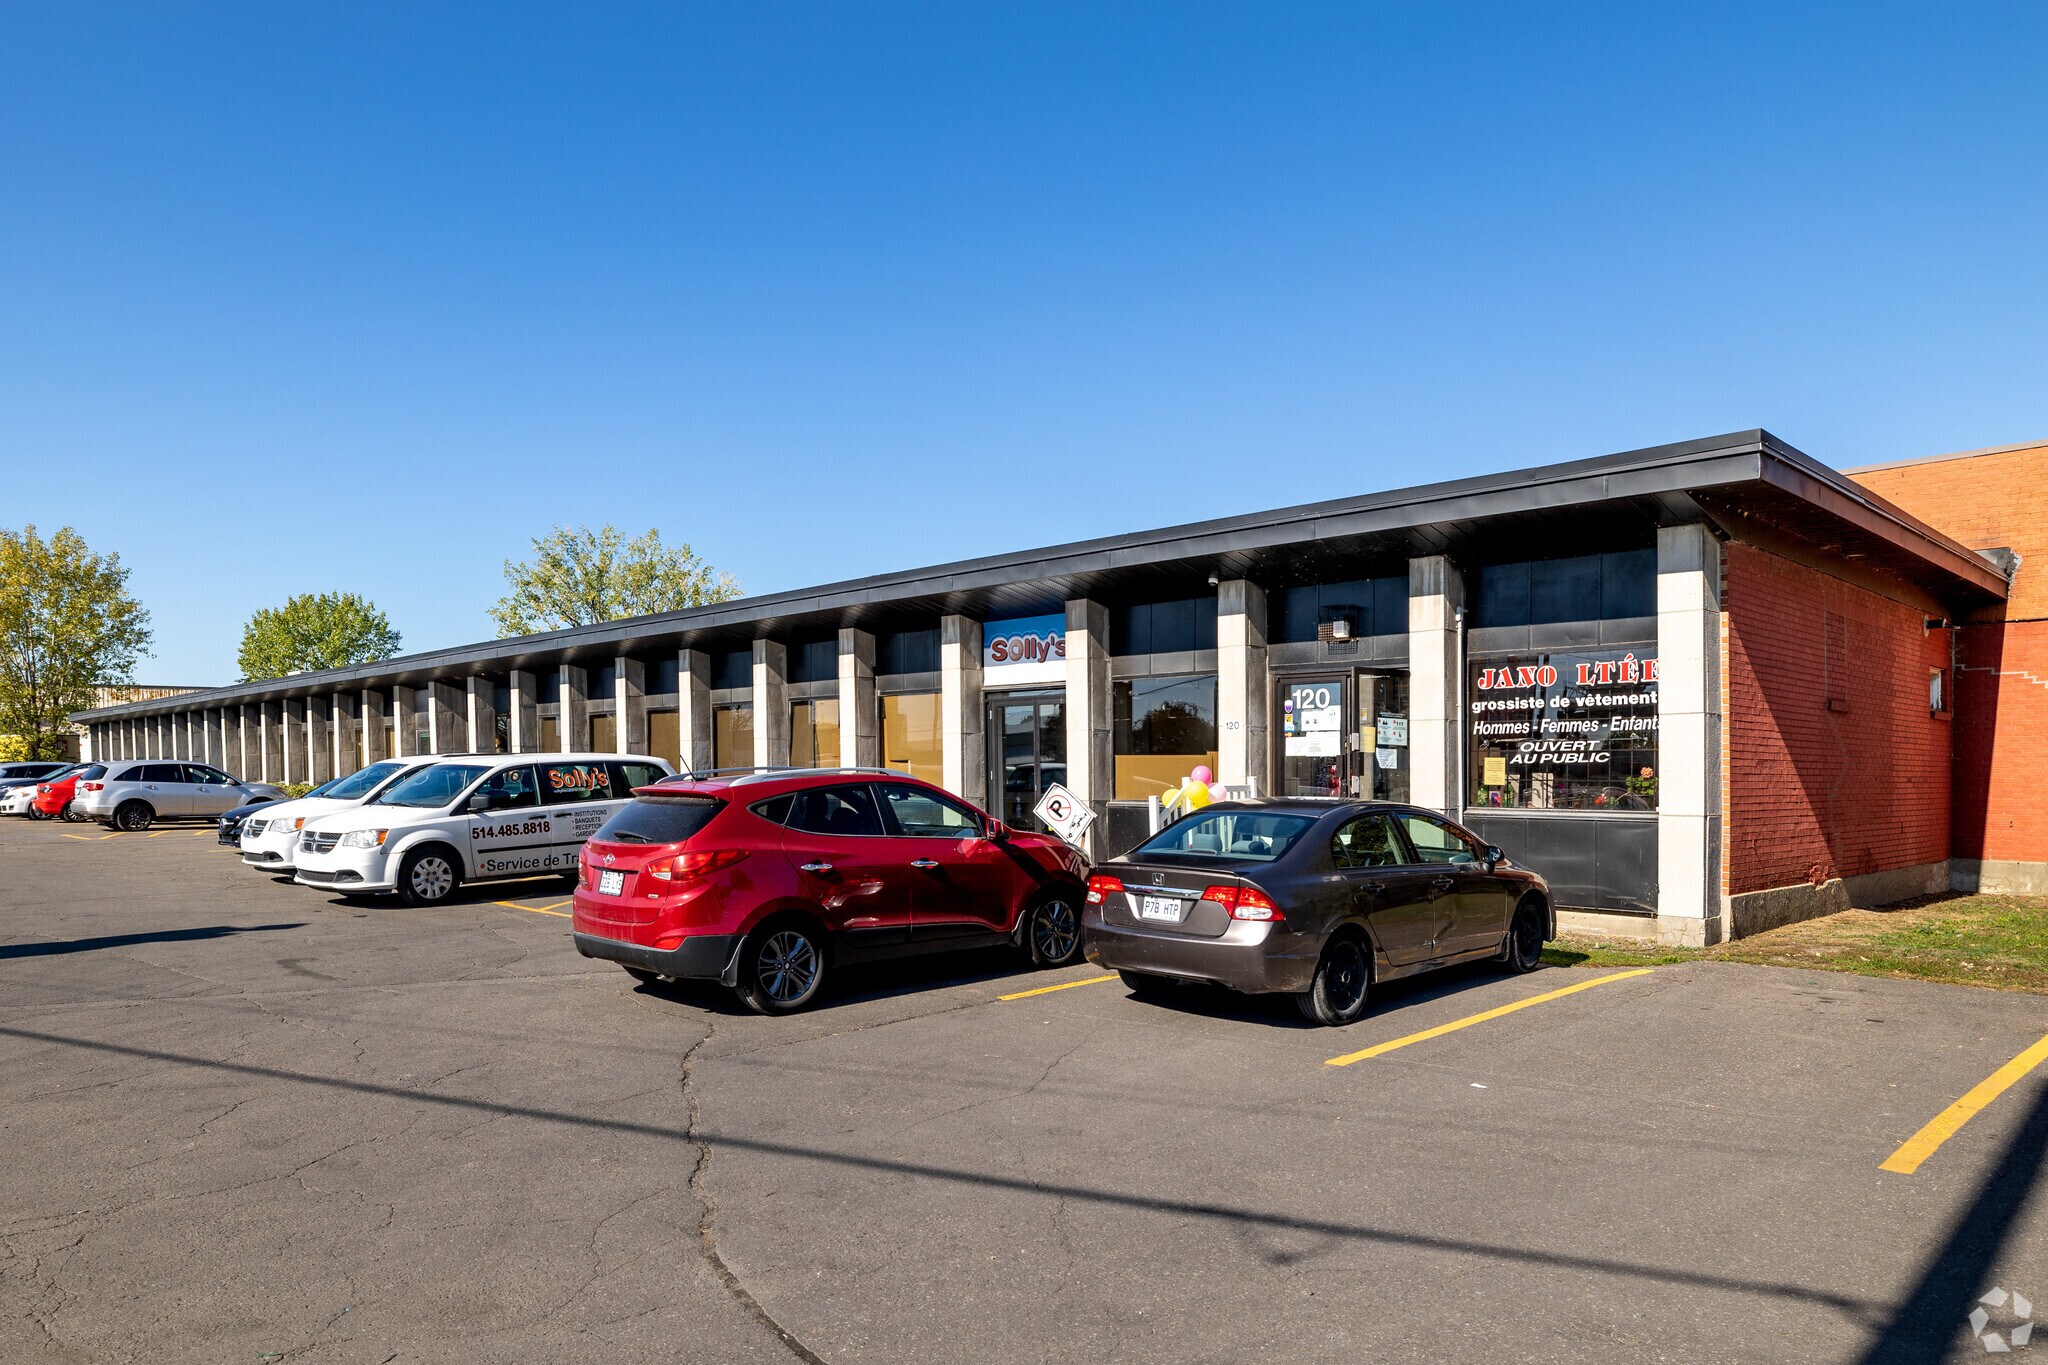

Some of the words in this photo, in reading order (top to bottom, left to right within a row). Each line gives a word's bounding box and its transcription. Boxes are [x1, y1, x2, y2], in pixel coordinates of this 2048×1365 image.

[1477, 665, 1557, 690] JANO
[1292, 688, 1331, 709] 120
[1471, 696, 1545, 714] grossiste
[1550, 695, 1570, 708] de
[1225, 721, 1240, 730] 120
[1473, 720, 1530, 735] Hommes
[1540, 718, 1599, 733] Femmes
[1520, 740, 1600, 752] OUVERT
[1509, 753, 1539, 765] AU
[1540, 752, 1611, 764] PUBLIC
[548, 767, 609, 790] Solly's
[574, 809, 607, 817] INSTITUTIONS
[472, 821, 550, 839] 514.485.8818
[575, 823, 605, 831] RECEPTION
[487, 857, 540, 872] Service
[543, 854, 560, 867] de
[1163, 903, 1179, 915] HTP
